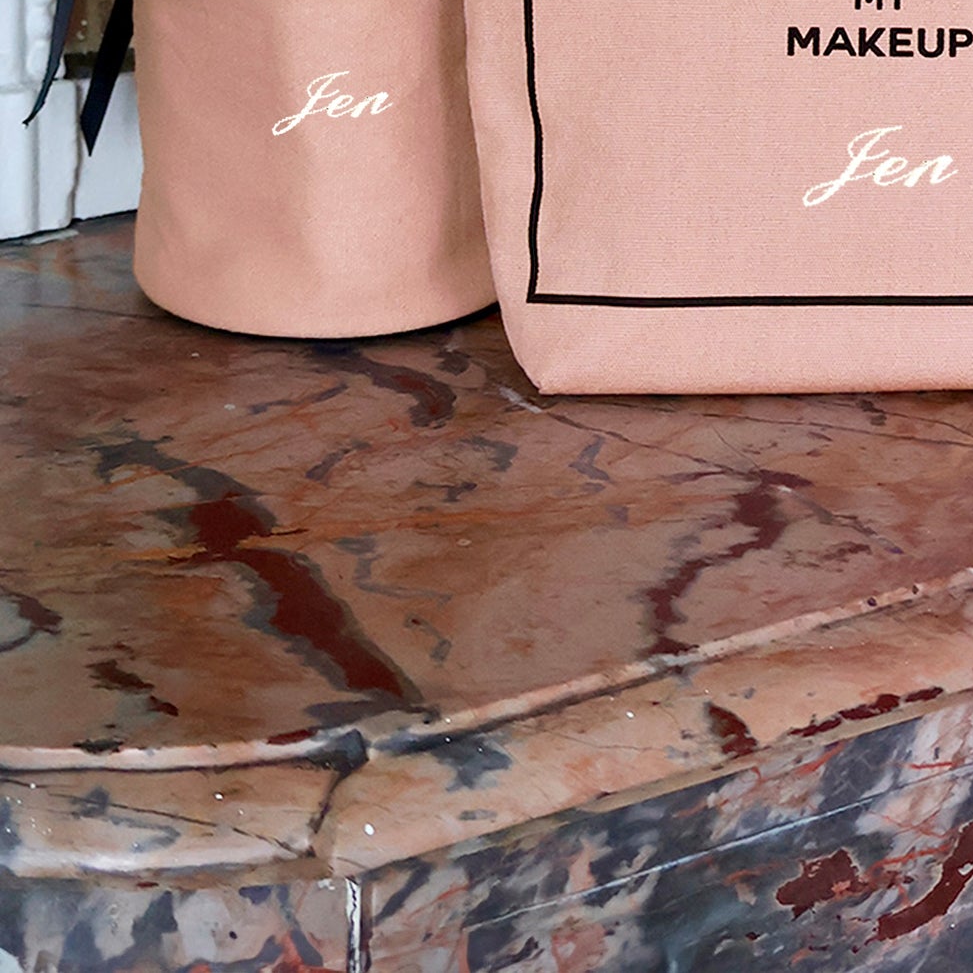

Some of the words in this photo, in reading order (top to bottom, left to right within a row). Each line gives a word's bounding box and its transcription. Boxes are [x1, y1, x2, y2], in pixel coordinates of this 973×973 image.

[788, 27, 973, 58] MAKEUP
[272, 70, 392, 136] Jen
[802, 124, 958, 208] Jen
